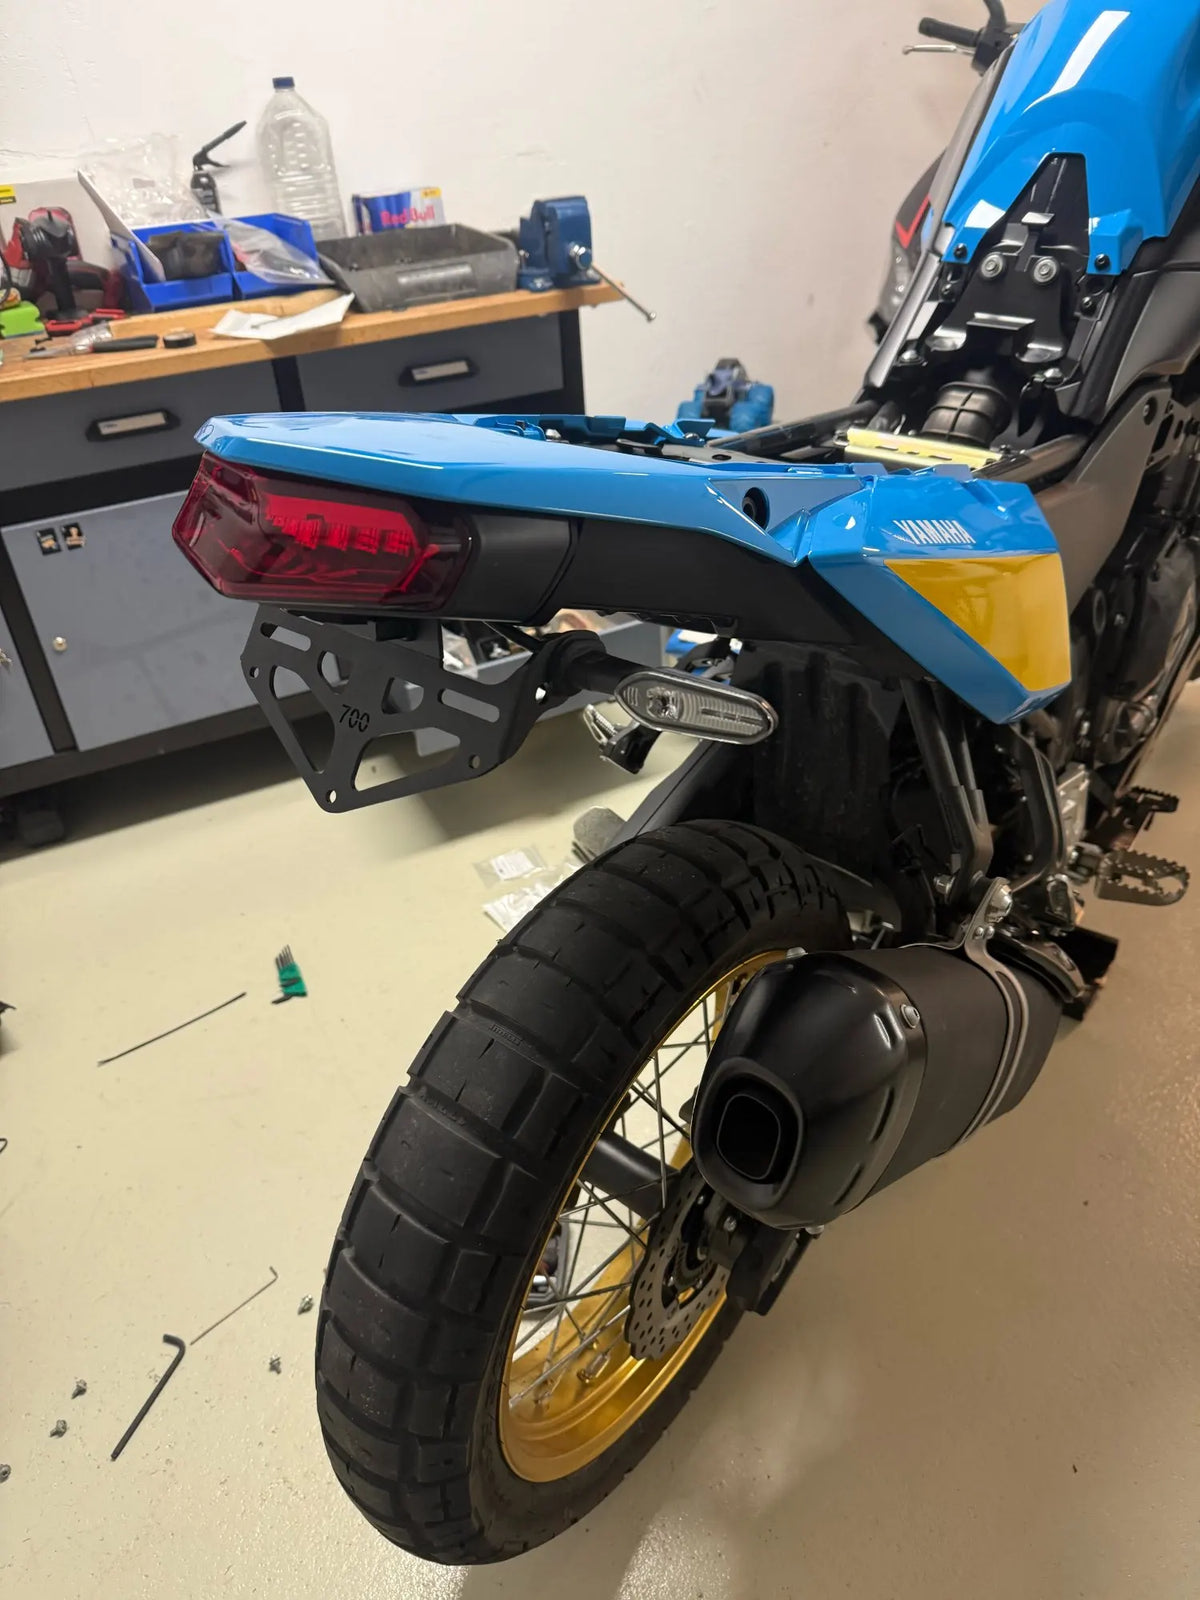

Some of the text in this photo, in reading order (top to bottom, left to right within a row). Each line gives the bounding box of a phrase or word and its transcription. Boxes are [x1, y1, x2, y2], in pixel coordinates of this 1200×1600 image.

[381, 207, 408, 227] Red
[893, 519, 976, 545] YAMAHA
[339, 703, 370, 732] 700
